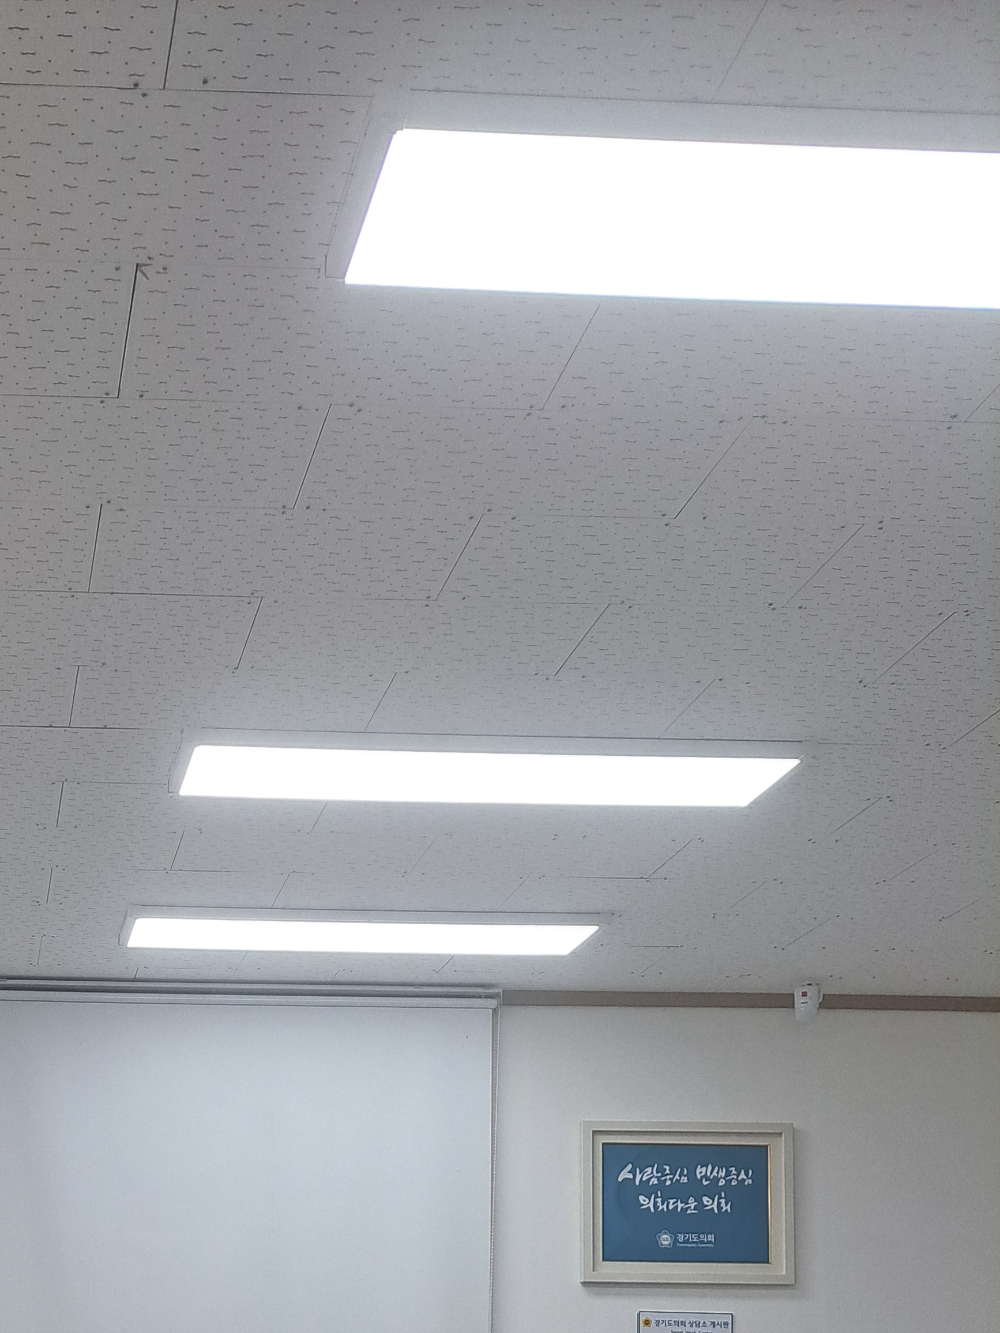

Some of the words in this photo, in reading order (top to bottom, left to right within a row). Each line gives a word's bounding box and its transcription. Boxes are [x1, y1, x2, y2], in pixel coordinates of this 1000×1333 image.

[617, 1163, 689, 1186] 사람중심
[695, 1164, 753, 1187] 민생중심
[638, 1191, 699, 1214] 의회다운
[702, 1191, 732, 1214] 의회
[676, 1233, 715, 1243] 경기도의회
[654, 1319, 687, 1328] 경기도의회
[688, 1320, 708, 1329] 상담소
[709, 1320, 730, 1329] 게시판
